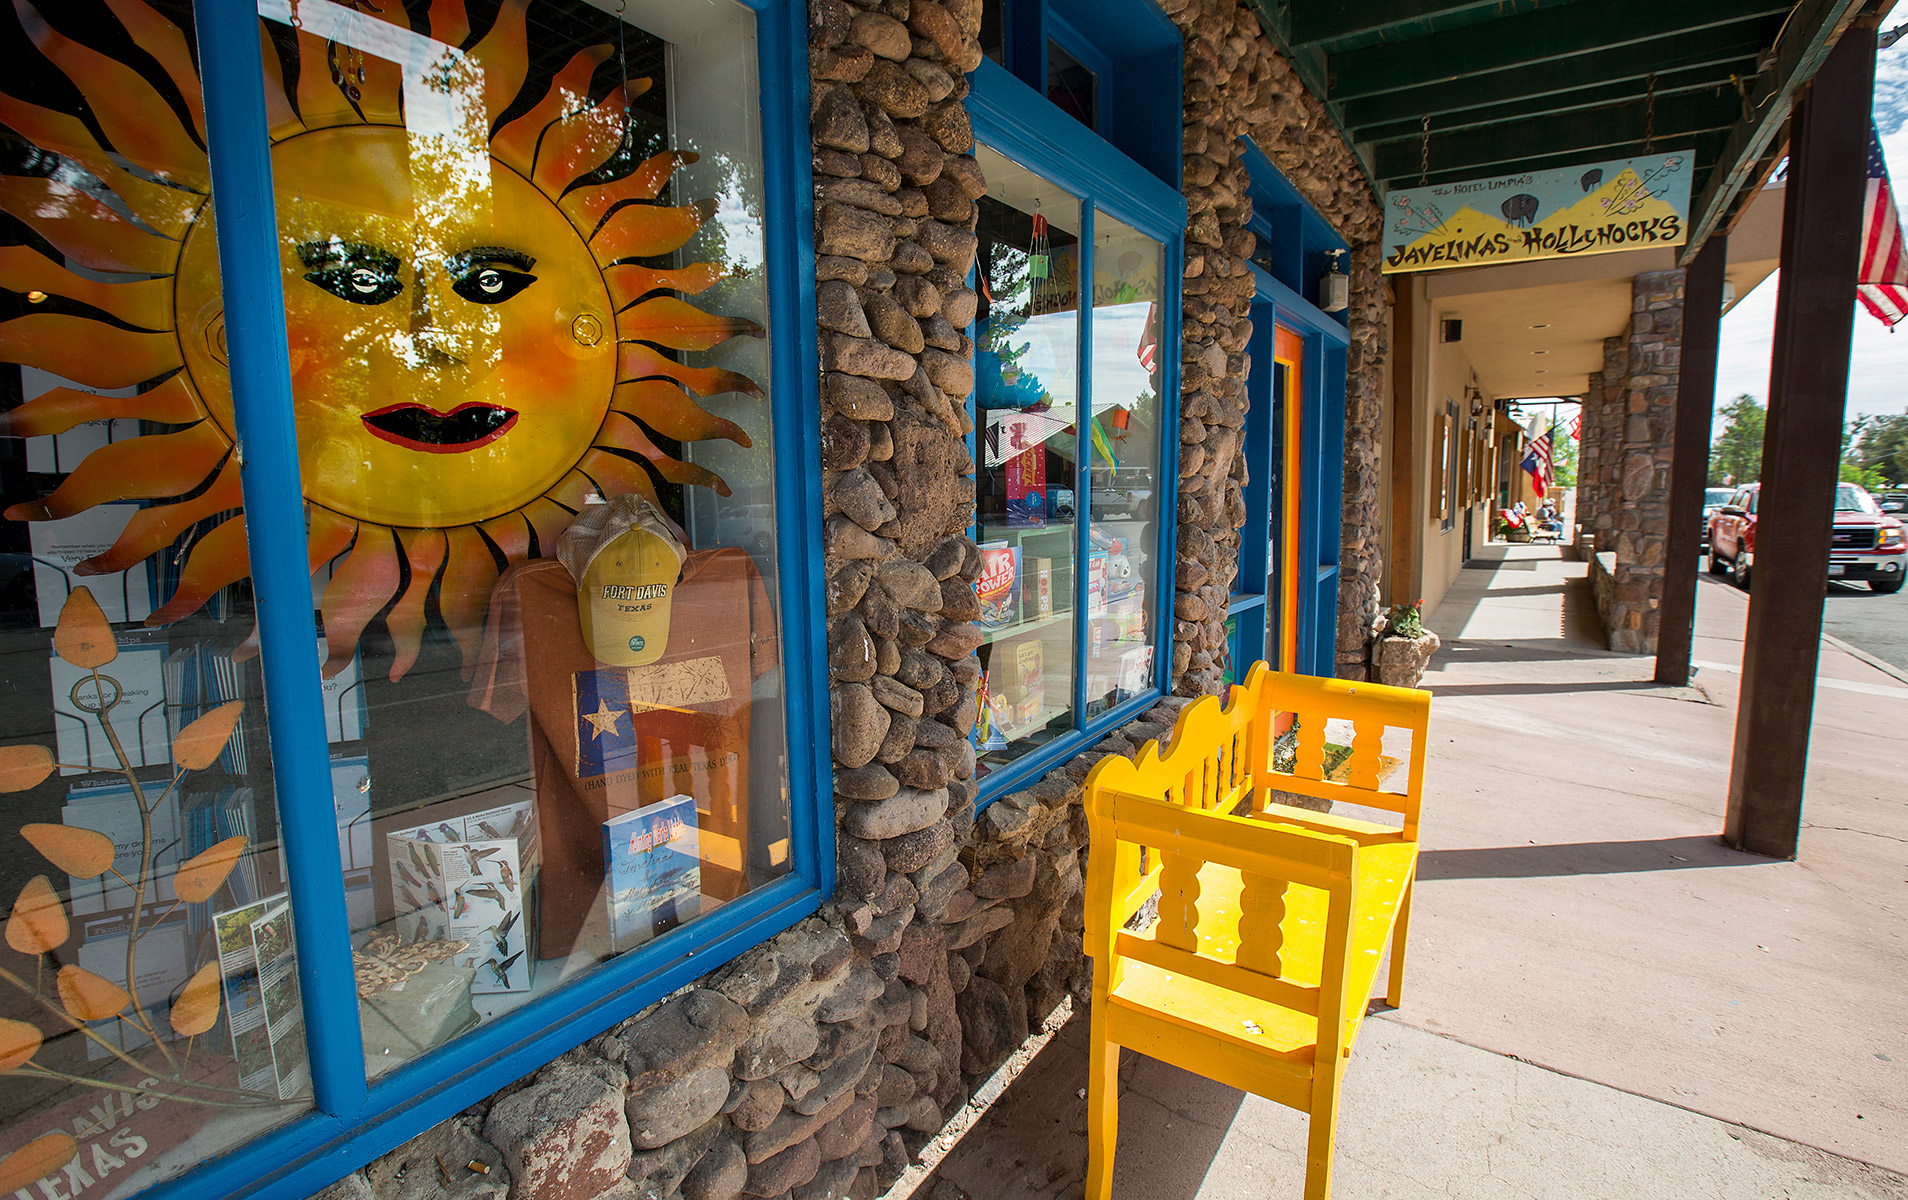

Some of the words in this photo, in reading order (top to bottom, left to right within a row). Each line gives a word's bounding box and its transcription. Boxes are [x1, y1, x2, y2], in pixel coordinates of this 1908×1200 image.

[1453, 183, 1486, 194] HOTEL
[1488, 174, 1533, 190] LIMPIA'S
[1387, 232, 1509, 267] JAVELINAS
[1521, 215, 1681, 254] HOLLYHOCKS
[61, 554, 84, 563] Very
[602, 584, 635, 600] FORT
[635, 583, 668, 600] DAVIS
[1040, 569, 1048, 611] HOOPS
[617, 603, 652, 612] TEXAS
[80, 777, 128, 787] Whateve
[584, 777, 613, 792] (HAND
[616, 772, 640, 785] DYED
[642, 766, 665, 779] WITH
[668, 763, 690, 774] REAL
[693, 759, 717, 772] TEXAS
[132, 837, 166, 848] drms
[33, 1077, 161, 1141] AVIS
